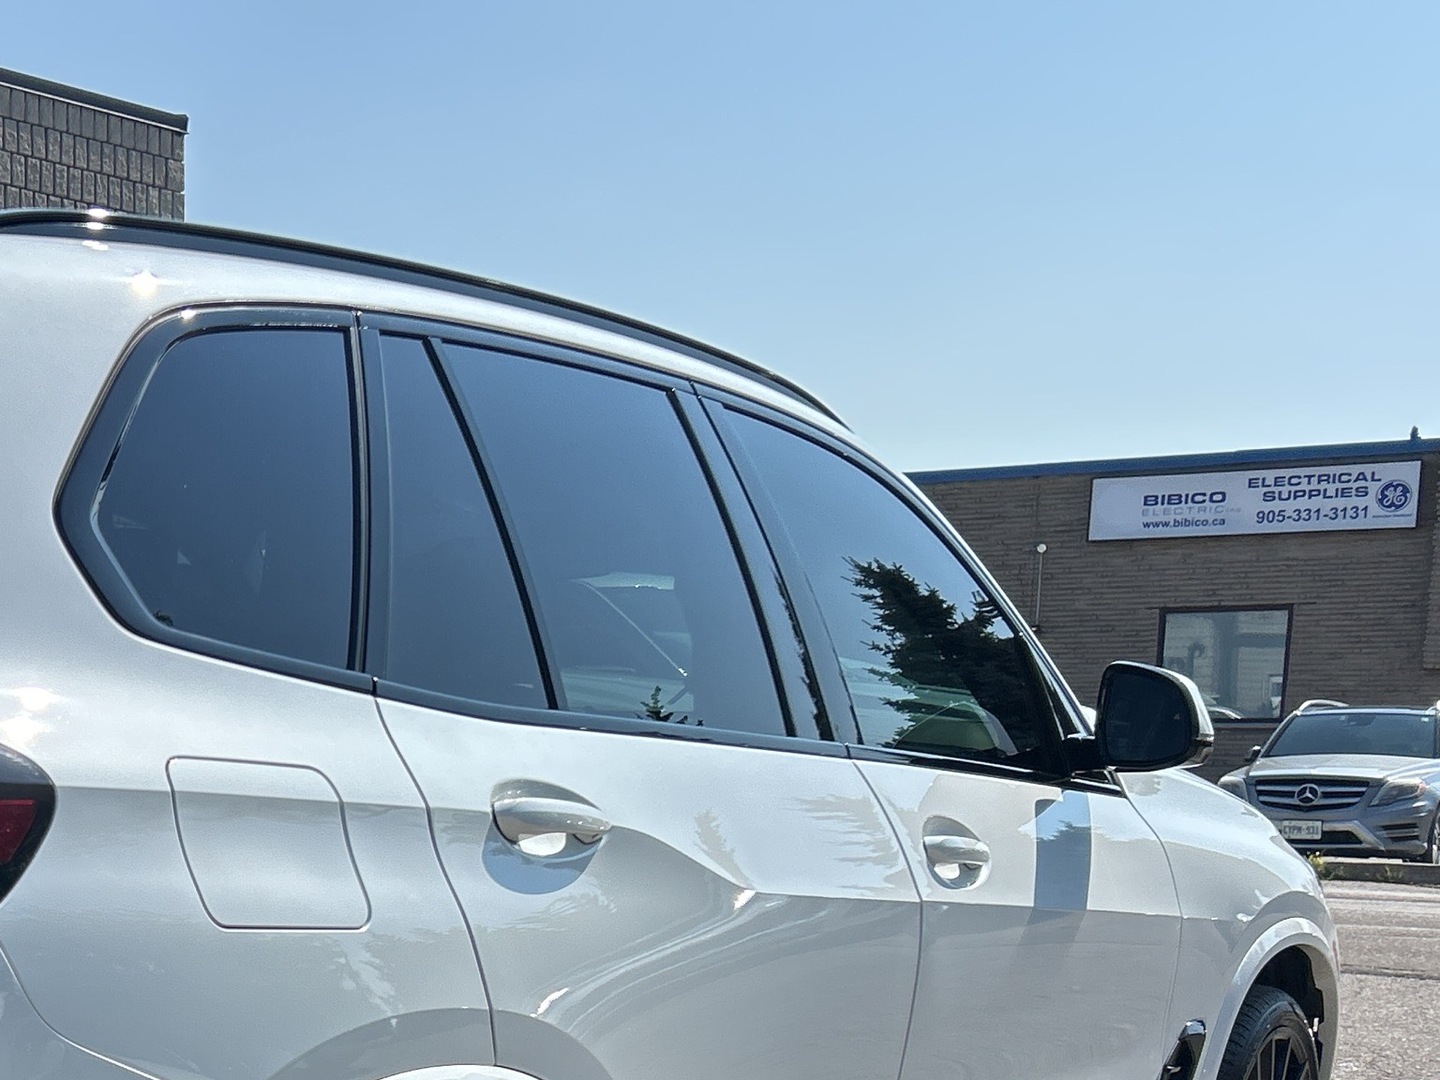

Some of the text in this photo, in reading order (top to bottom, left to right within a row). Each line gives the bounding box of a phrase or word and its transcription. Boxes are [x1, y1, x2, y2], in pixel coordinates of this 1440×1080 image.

[1248, 472, 1382, 489] ELECTRICAL
[1143, 491, 1227, 507] BIBICO
[1262, 486, 1369, 503] SUPPLIES
[1141, 505, 1225, 517] ELECTRIC
[1256, 505, 1369, 524] 905-331-3131
[1142, 517, 1226, 529] www.bibico.ca
